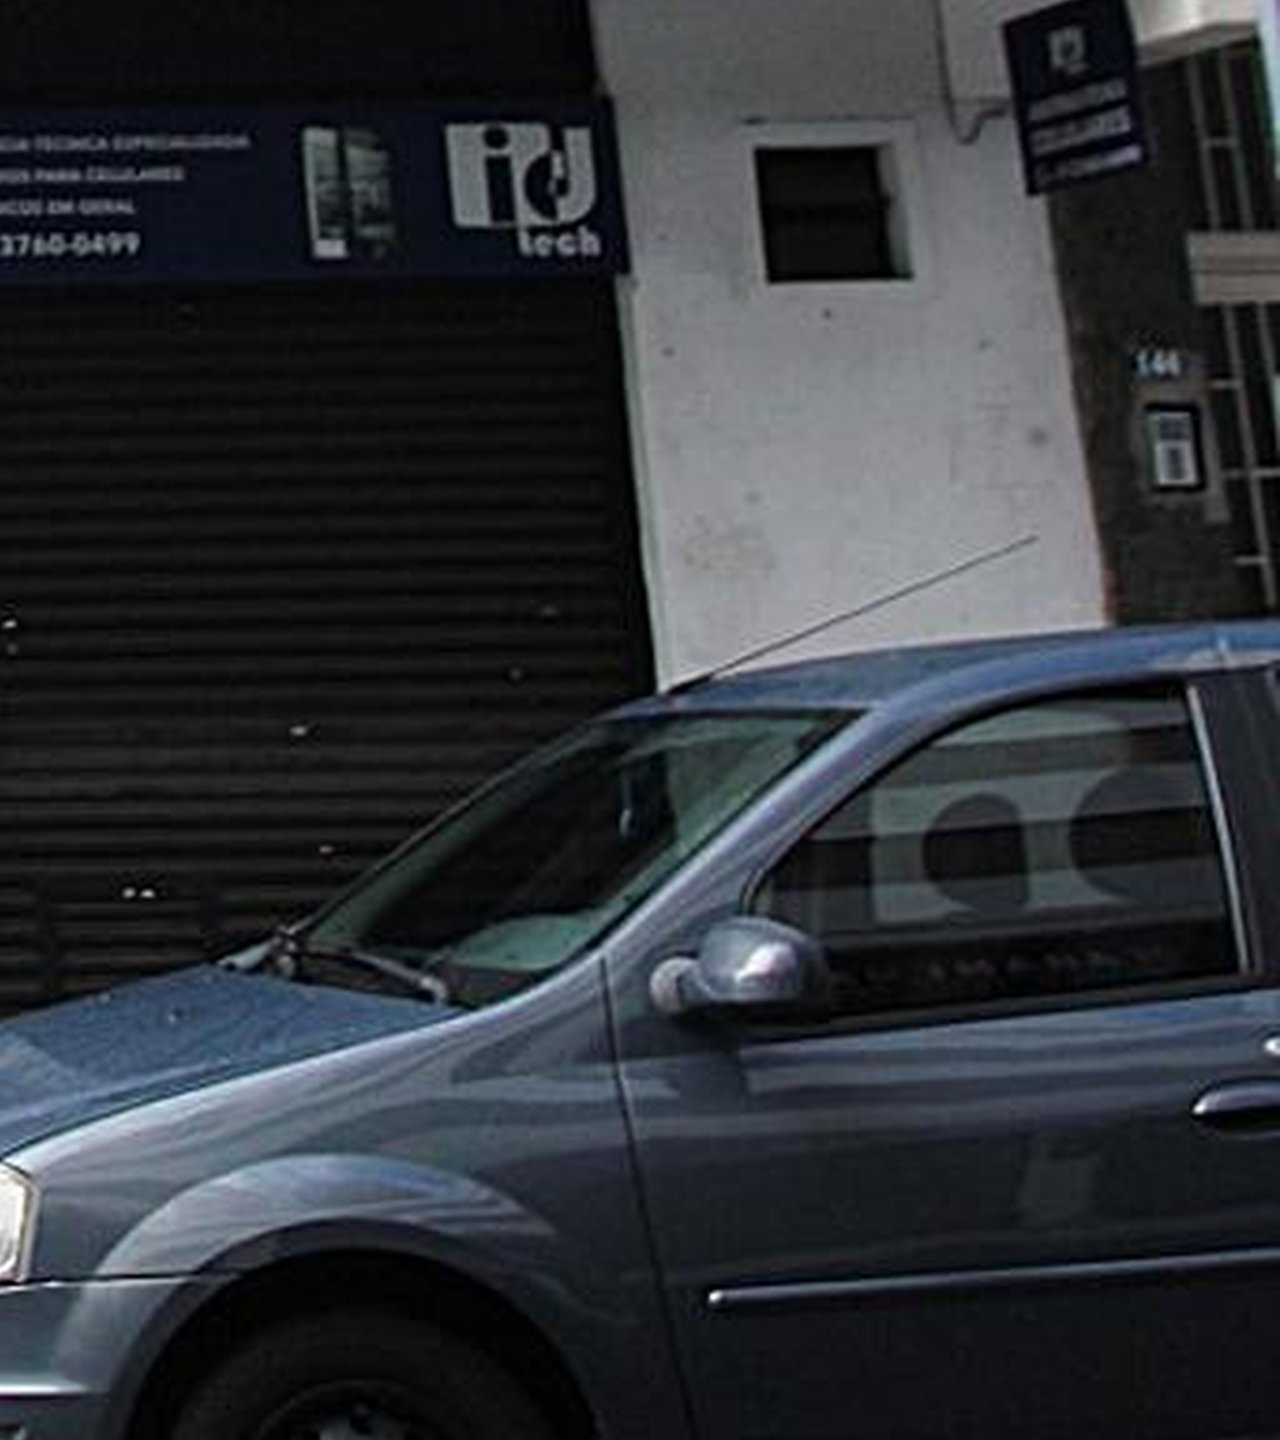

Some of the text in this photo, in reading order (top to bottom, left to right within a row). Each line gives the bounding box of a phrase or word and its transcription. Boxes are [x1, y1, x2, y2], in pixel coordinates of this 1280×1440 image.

[85, 166, 184, 182] CELULARES
[47, 198, 74, 215] EM
[78, 197, 135, 215] GERAL
[518, 223, 601, 256] tech
